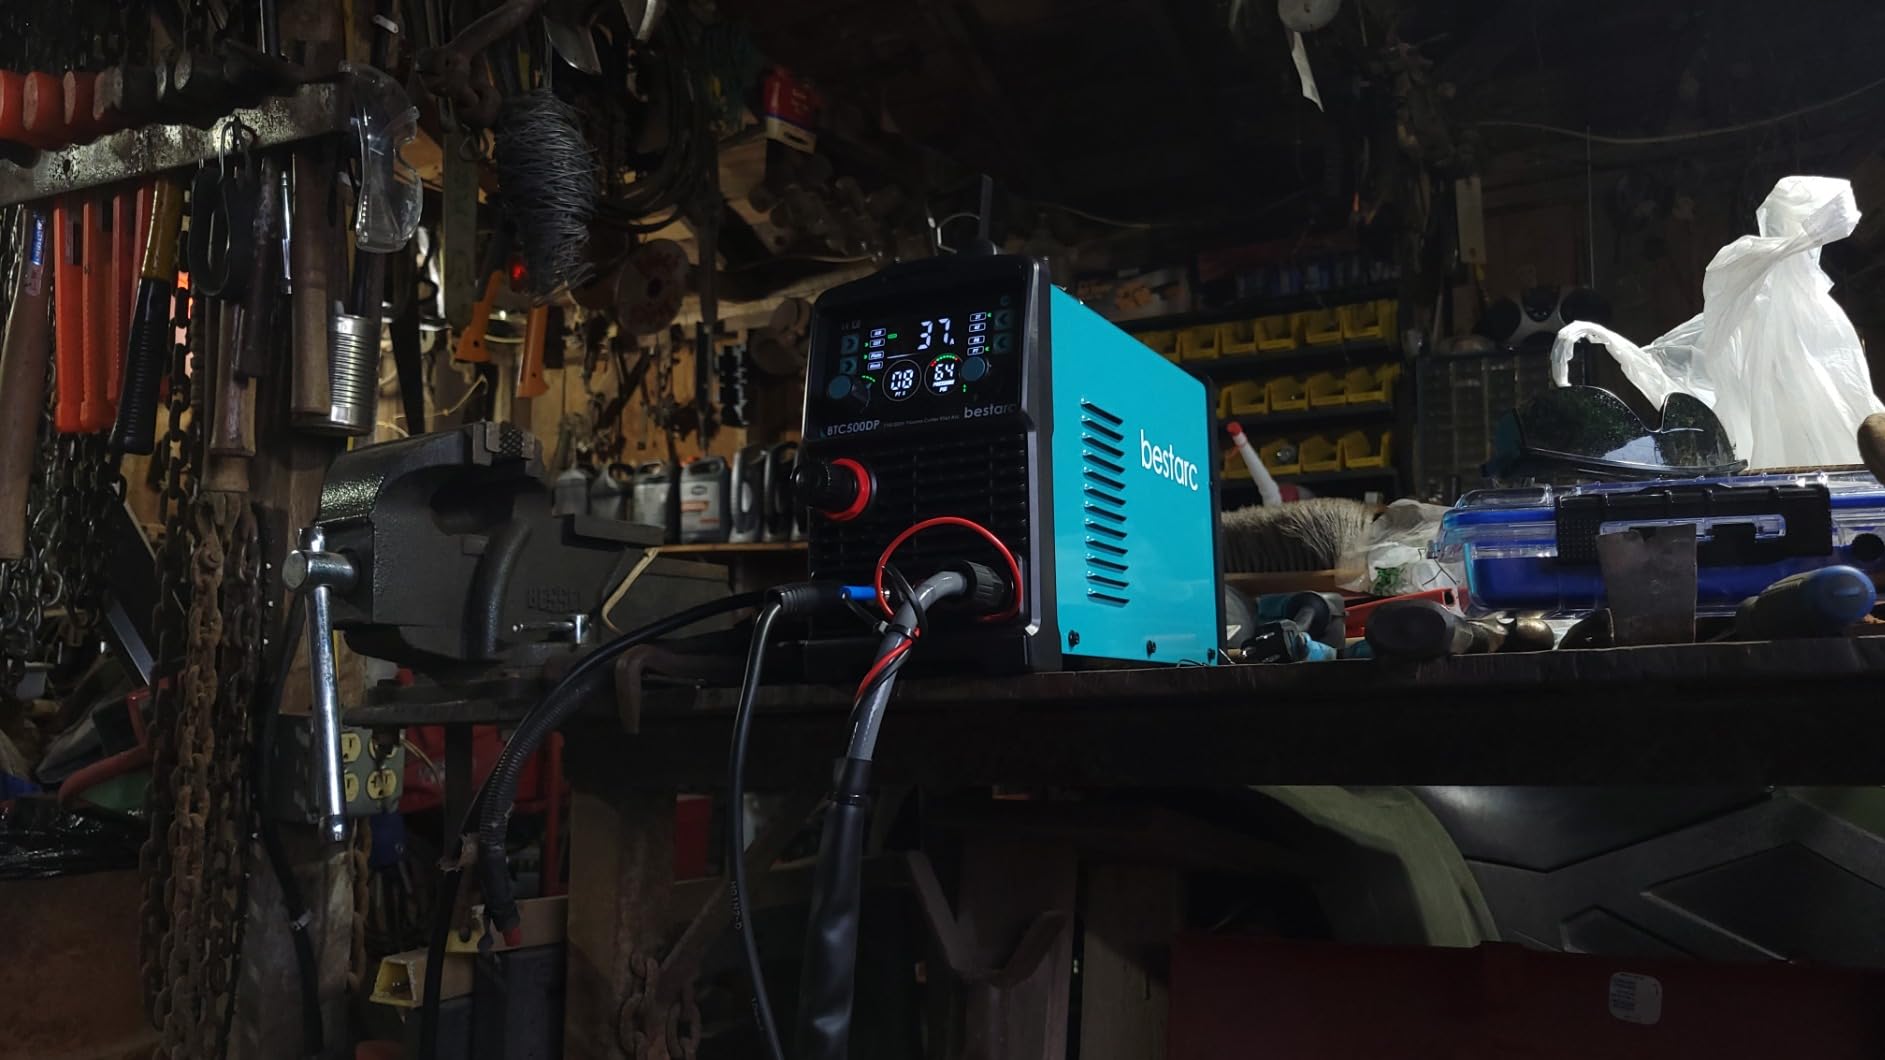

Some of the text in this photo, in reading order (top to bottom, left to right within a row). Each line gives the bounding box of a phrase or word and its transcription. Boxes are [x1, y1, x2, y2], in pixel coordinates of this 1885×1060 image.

[890, 369, 914, 391] 08
[934, 363, 955, 381] 64
[963, 403, 1018, 419] bestarc
[826, 419, 881, 437] BTC500DP
[1140, 428, 1199, 491] bestarc
